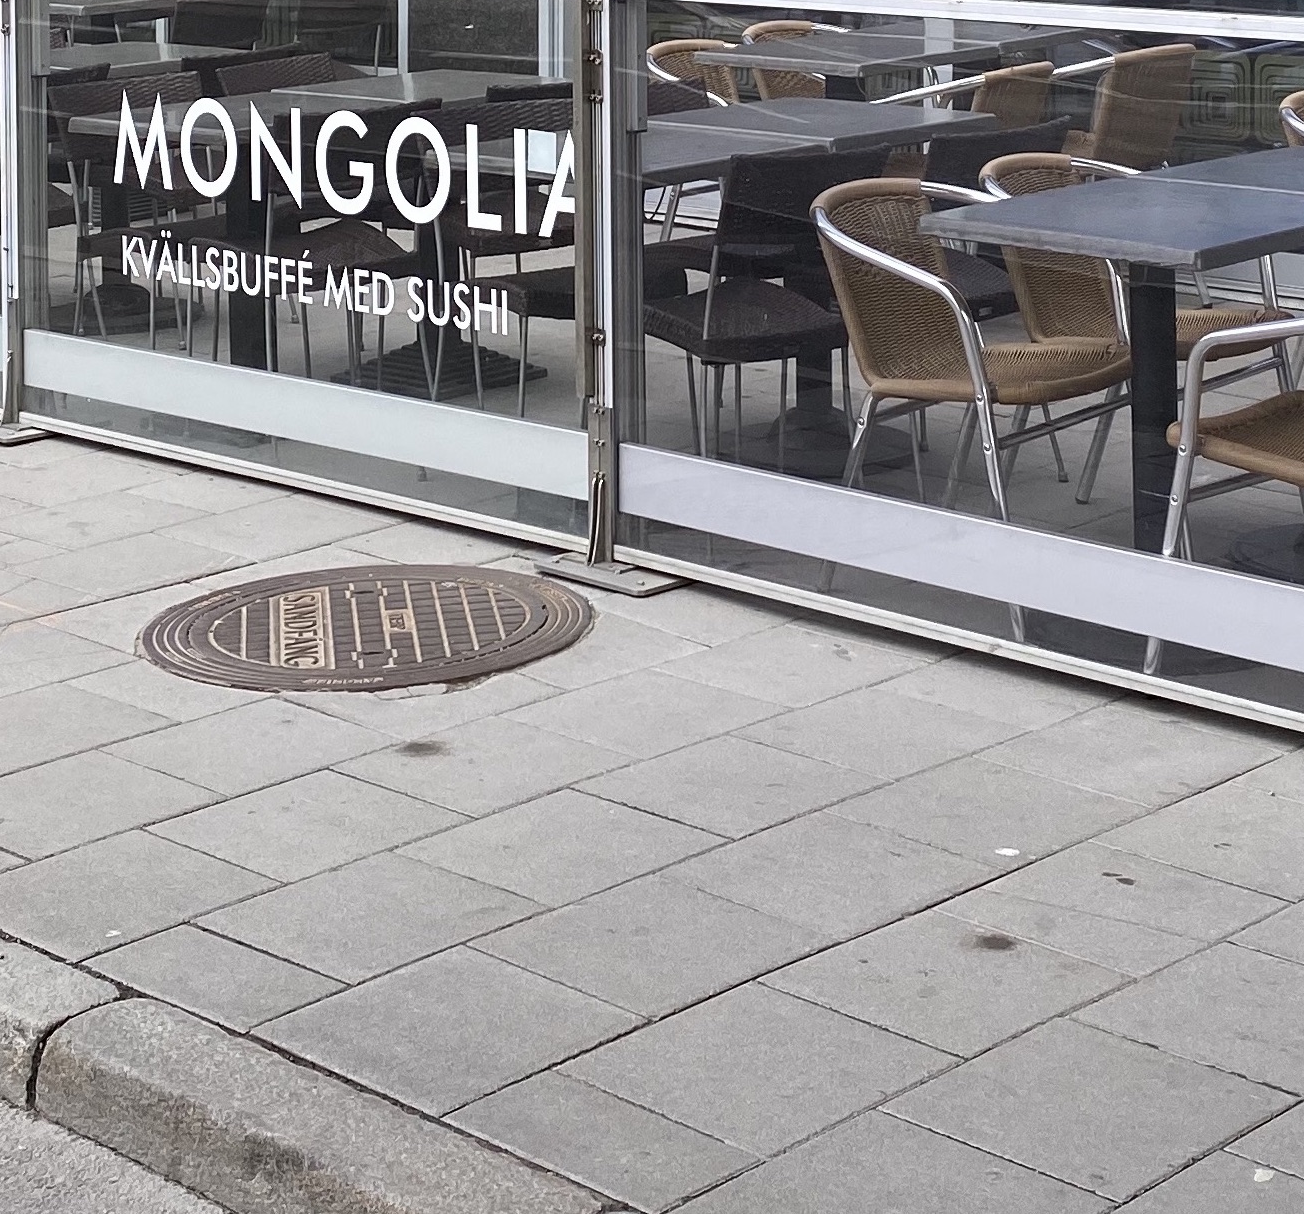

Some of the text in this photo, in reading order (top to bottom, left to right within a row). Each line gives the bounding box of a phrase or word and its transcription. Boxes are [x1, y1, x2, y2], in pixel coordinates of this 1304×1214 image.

[121, 230, 509, 337] KVÄLLSBUFFÉ MED SUSHI
[282, 594, 324, 667] SANDFÅNG
